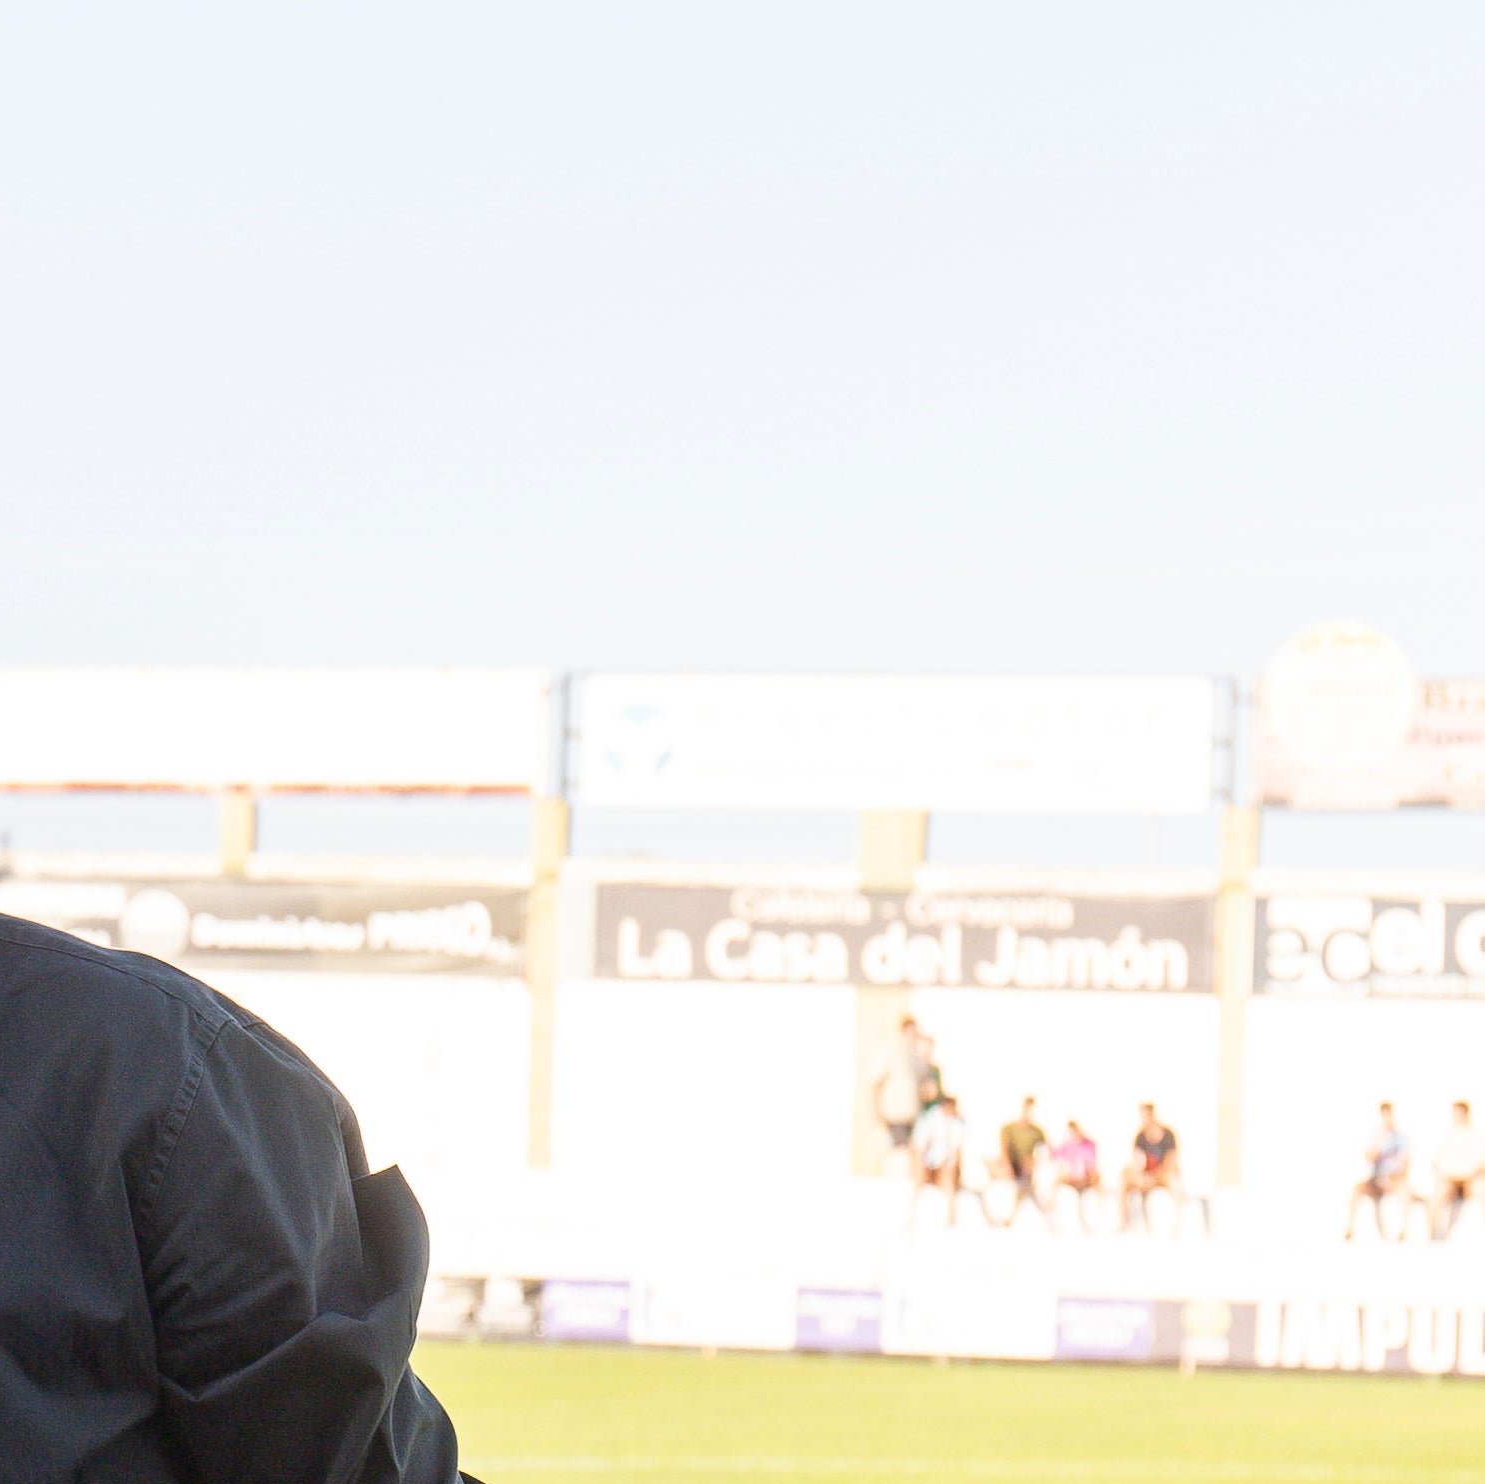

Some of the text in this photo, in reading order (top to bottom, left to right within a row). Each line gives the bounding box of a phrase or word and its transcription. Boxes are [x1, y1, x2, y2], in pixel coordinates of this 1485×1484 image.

[616, 916, 692, 980] La
[705, 917, 849, 983] Casa
[860, 920, 964, 986] del
[974, 922, 1189, 991] Jamón
